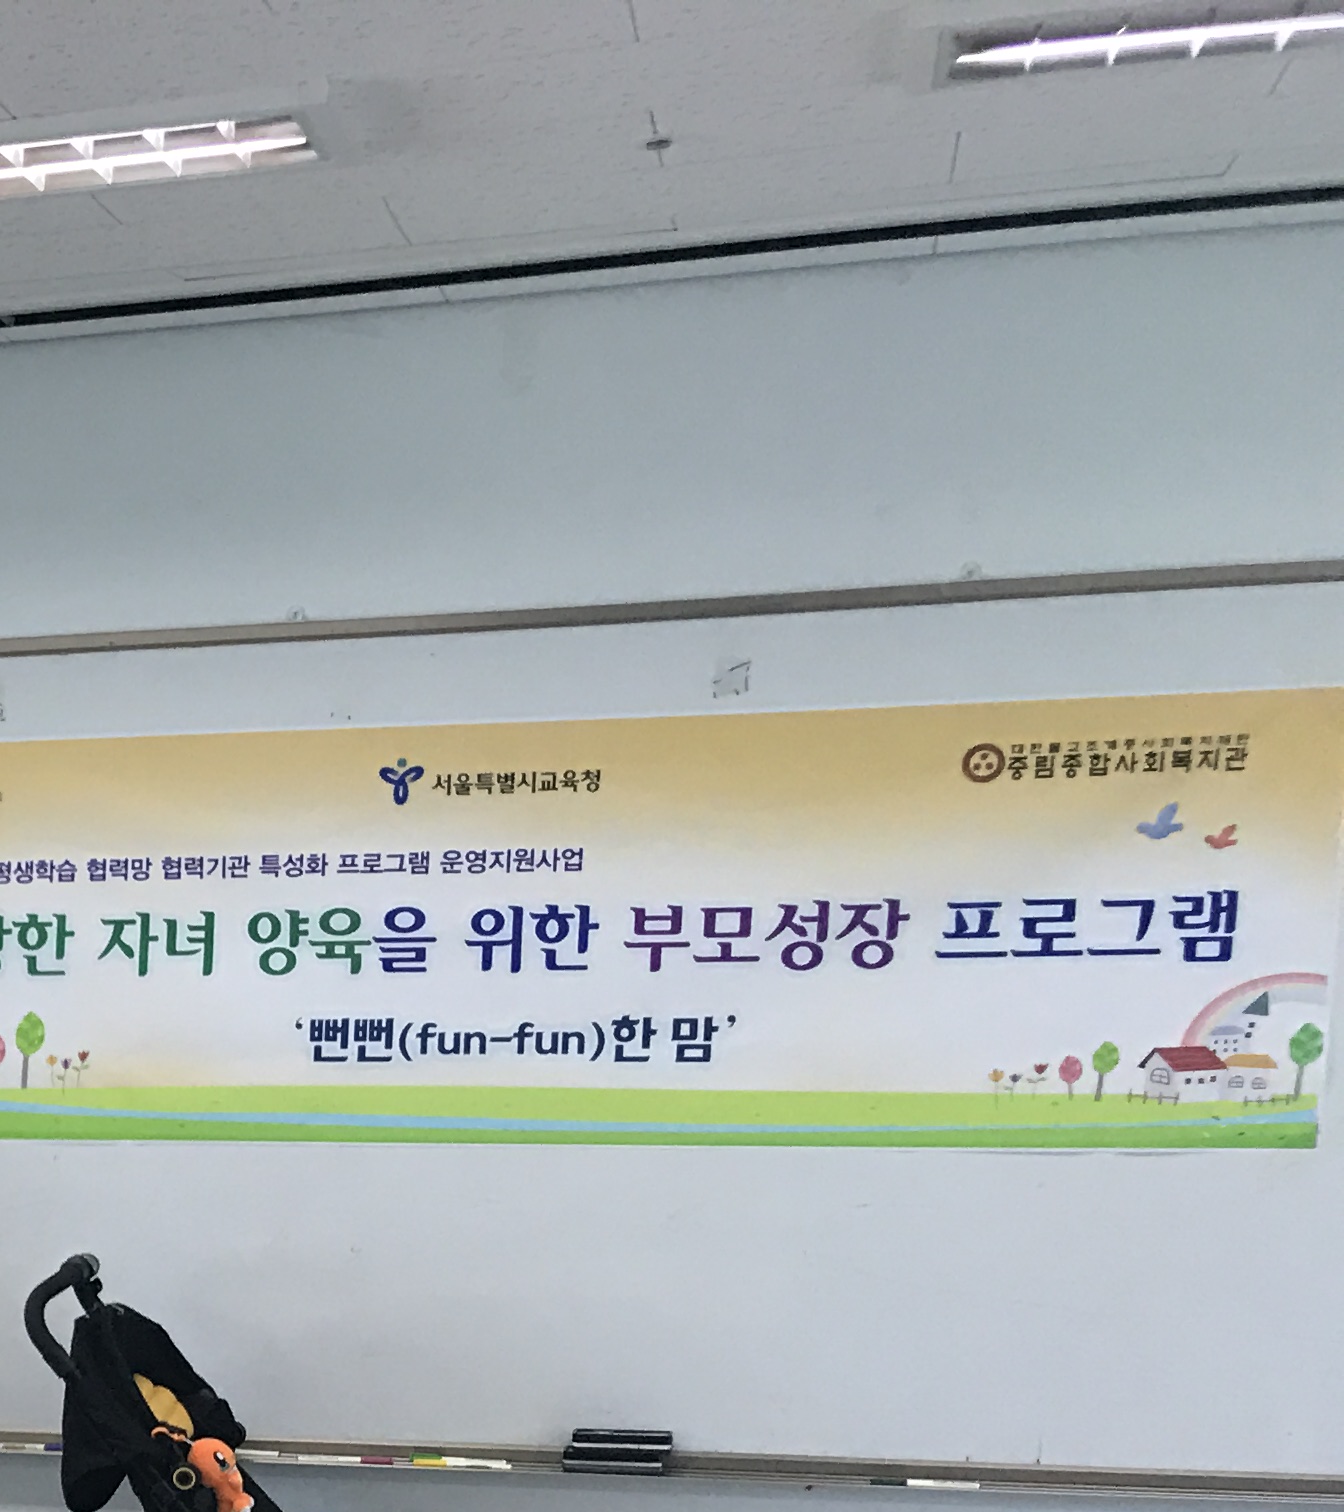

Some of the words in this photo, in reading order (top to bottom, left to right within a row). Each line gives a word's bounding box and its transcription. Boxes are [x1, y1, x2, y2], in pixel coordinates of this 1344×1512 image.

[1008, 747, 1248, 780] 중림종합사회복지관
[431, 768, 602, 796] 서울특별시교육청
[87, 857, 153, 882] 협력망
[161, 855, 251, 881] 협력기관
[259, 853, 329, 879] 특성화
[337, 850, 431, 877] 프로그램
[440, 847, 584, 875] 운영지원사업
[98, 910, 216, 977] 자녀
[247, 906, 438, 976] 양육을
[465, 904, 600, 973] 위한
[623, 898, 910, 972] 부모성장
[935, 889, 1240, 963] 프로그램
